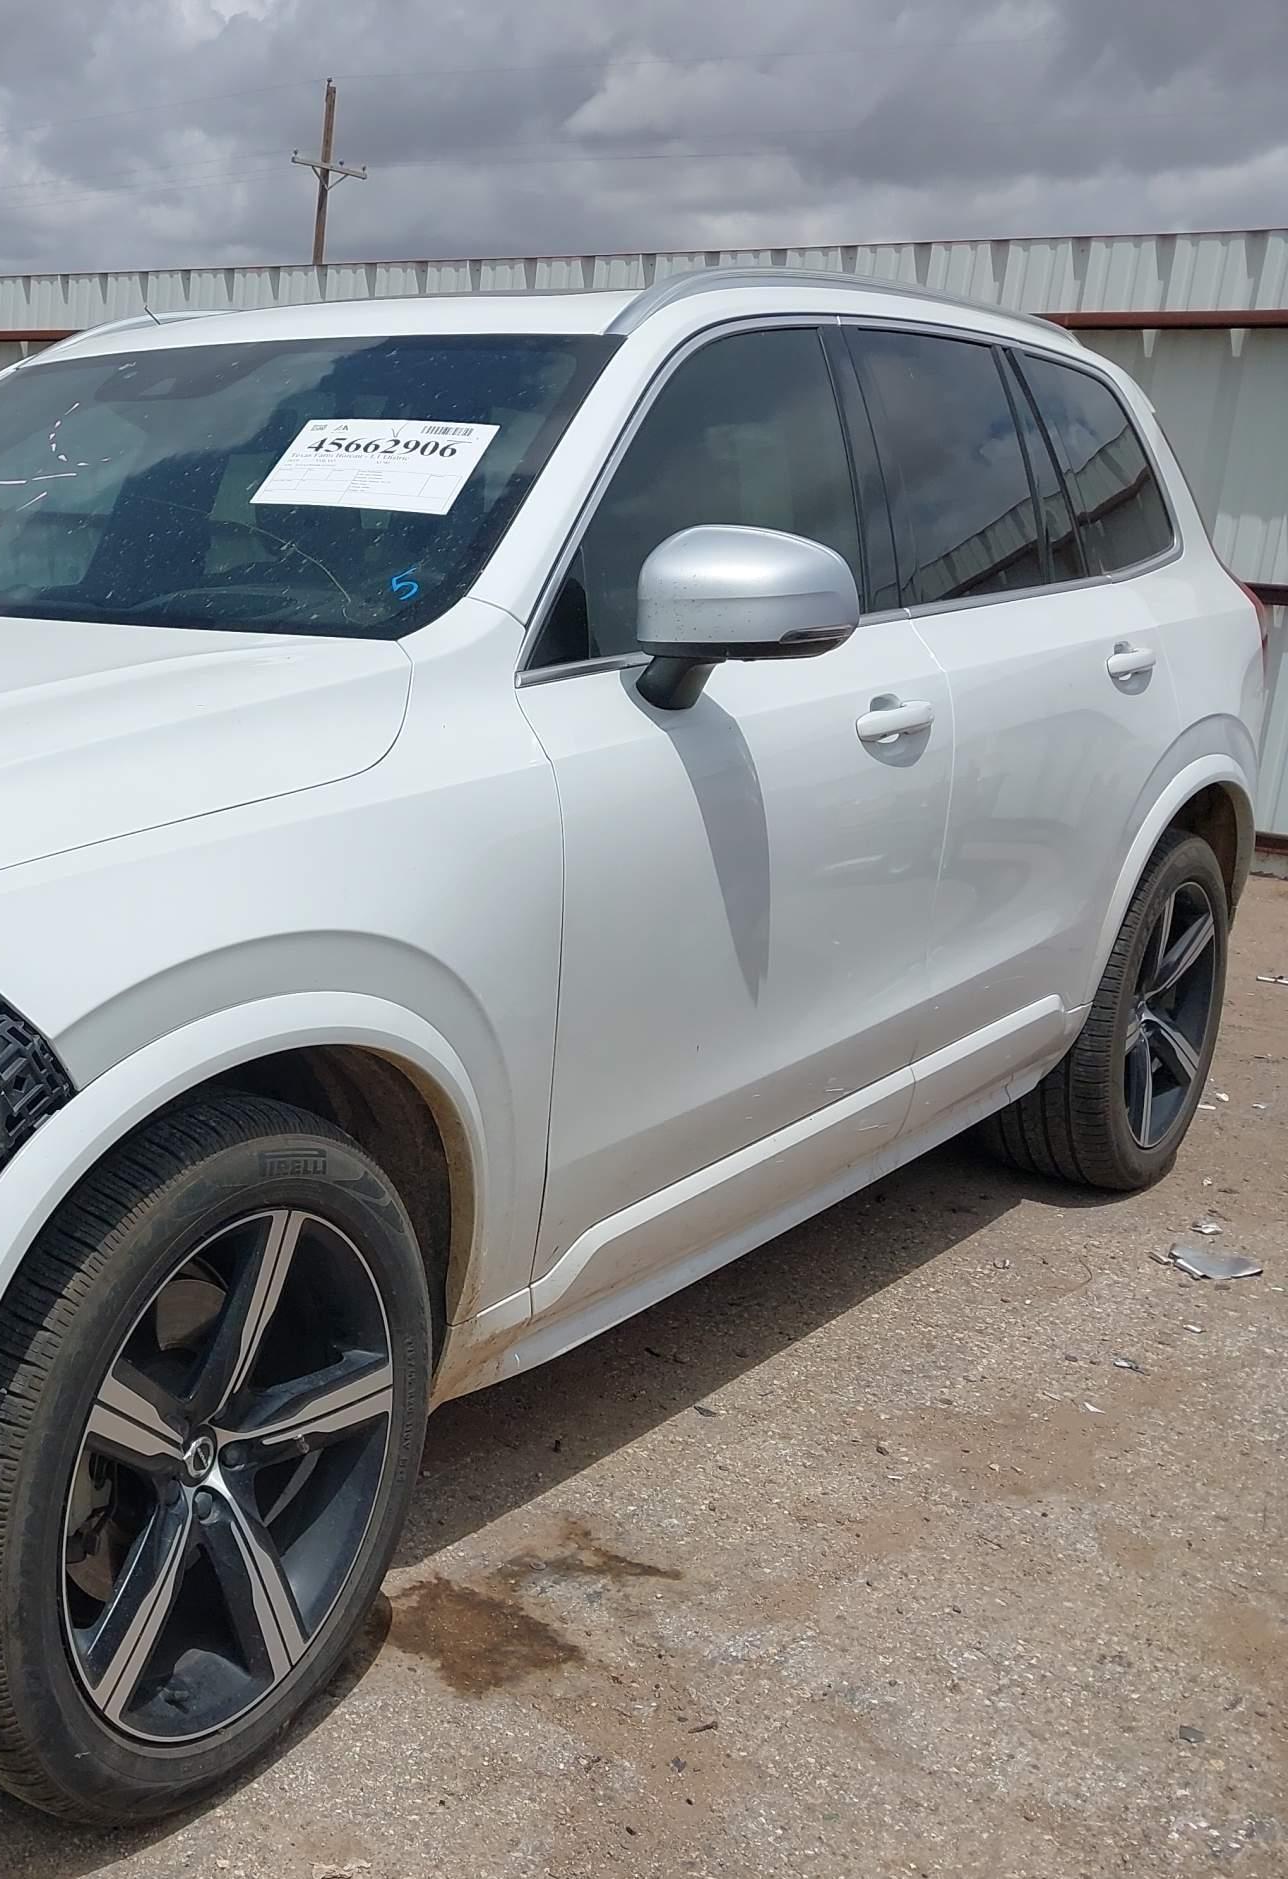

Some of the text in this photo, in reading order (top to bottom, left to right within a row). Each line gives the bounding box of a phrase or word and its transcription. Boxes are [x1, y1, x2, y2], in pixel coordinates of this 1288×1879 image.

[307, 436, 458, 458] 45662906
[391, 567, 419, 600] 5
[258, 1149, 327, 1177] PIRELLI
